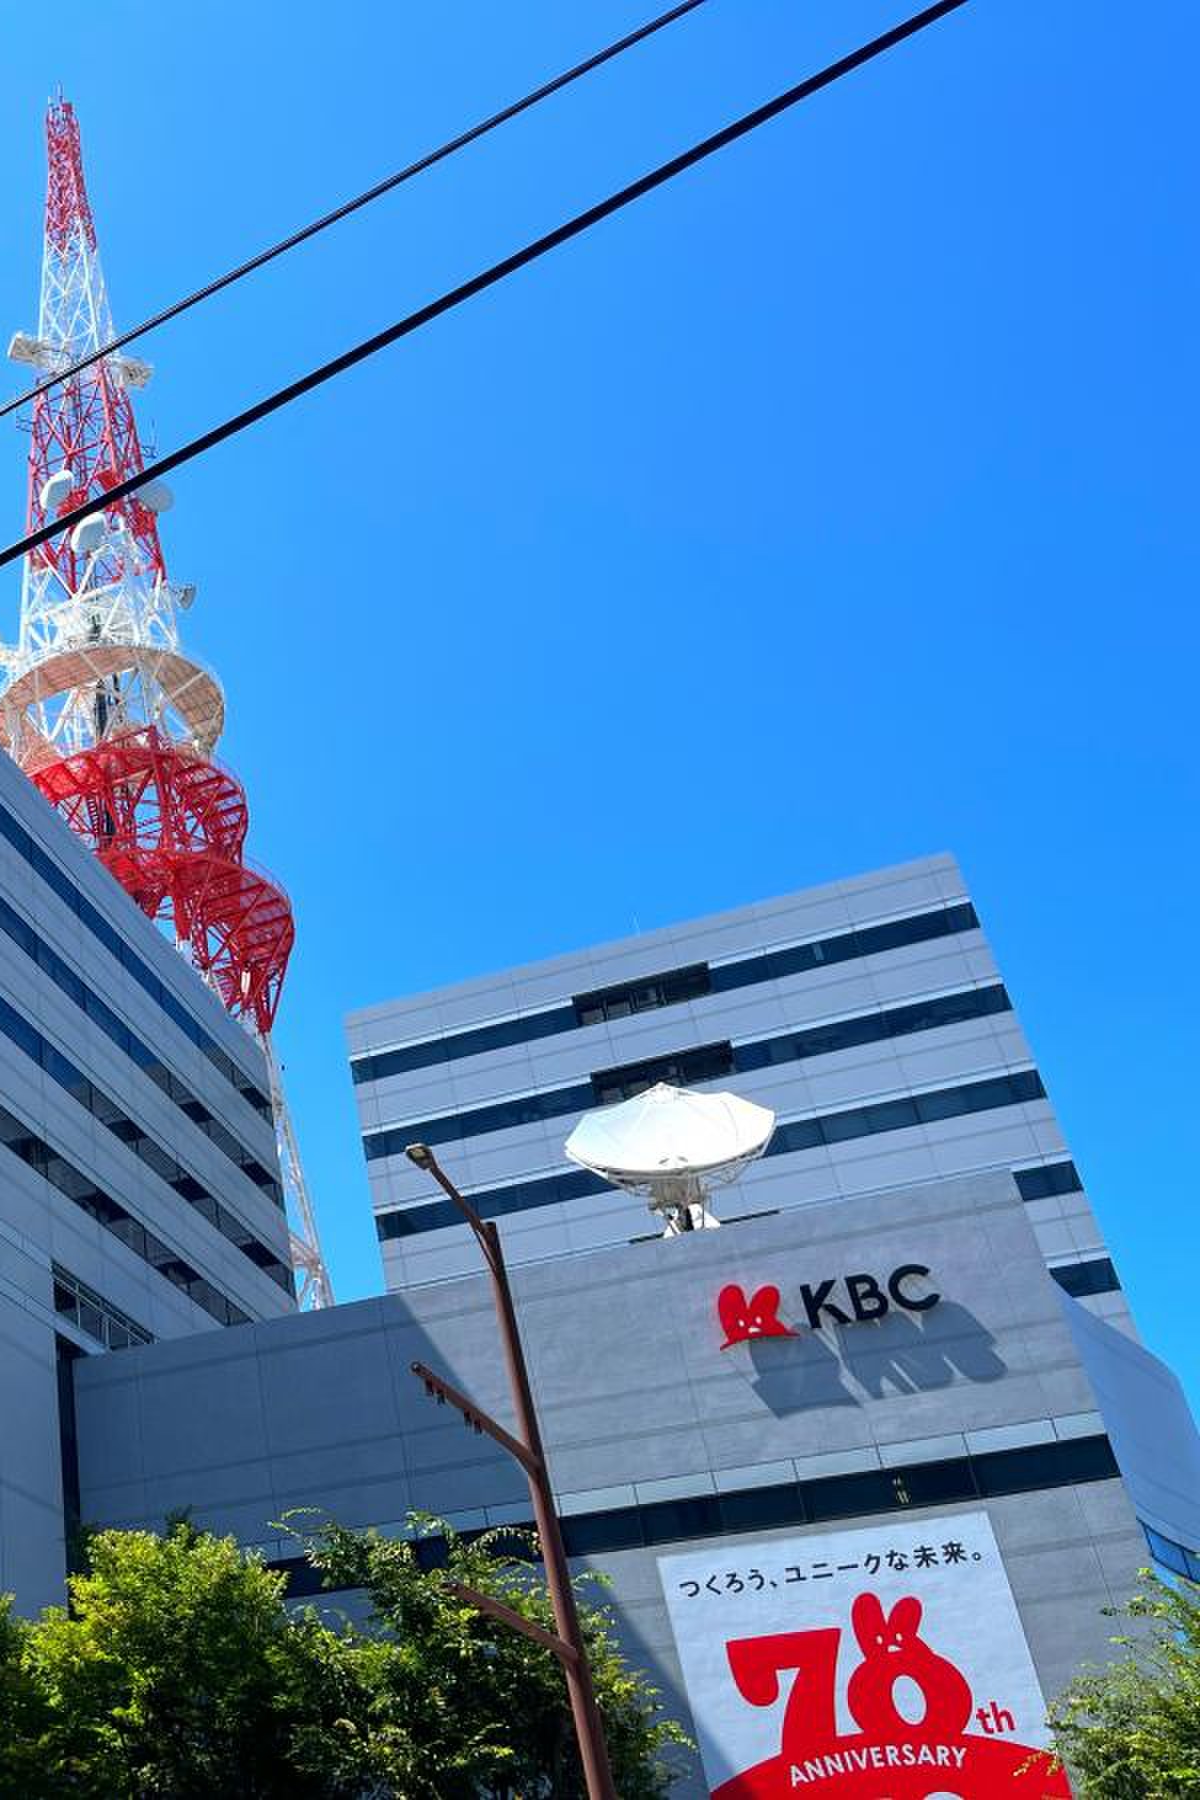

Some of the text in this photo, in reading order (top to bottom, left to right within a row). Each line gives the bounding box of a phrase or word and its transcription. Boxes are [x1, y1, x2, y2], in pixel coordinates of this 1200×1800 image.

[799, 1263, 941, 1331] KBC
[678, 1541, 983, 1598] つくろう、ユニークな未来。
[789, 1744, 967, 1788] ANNIVERSARY
